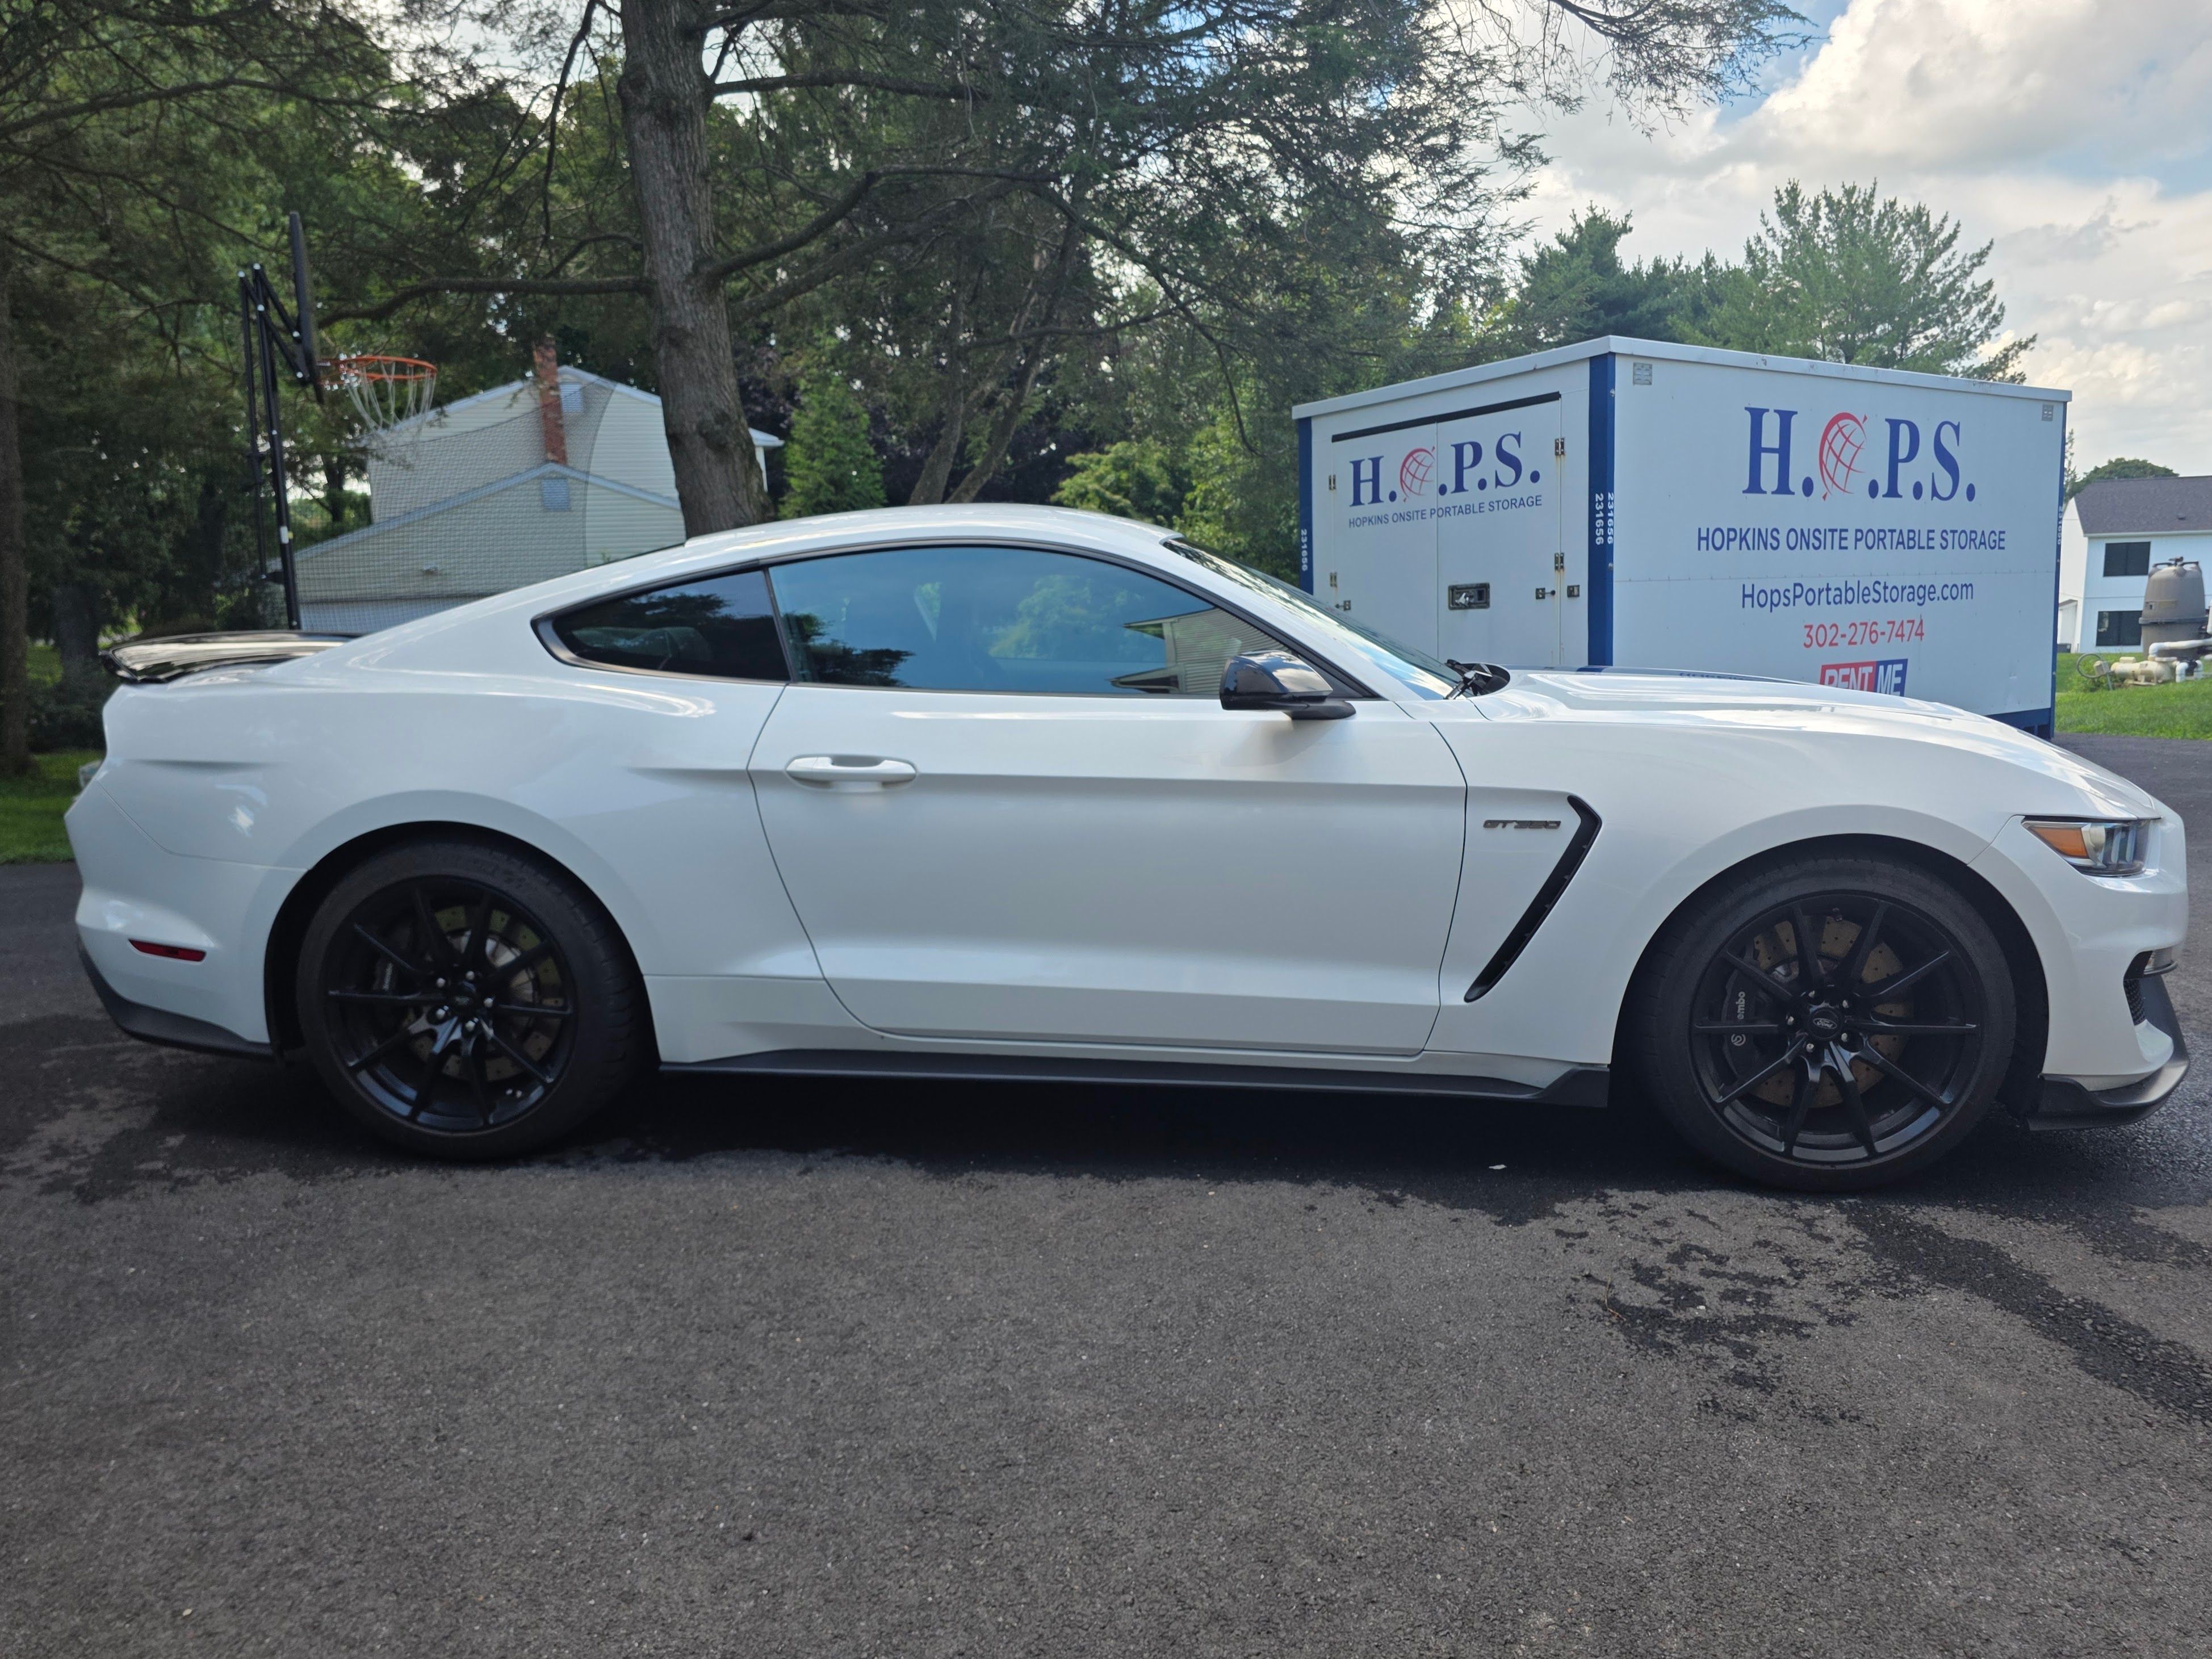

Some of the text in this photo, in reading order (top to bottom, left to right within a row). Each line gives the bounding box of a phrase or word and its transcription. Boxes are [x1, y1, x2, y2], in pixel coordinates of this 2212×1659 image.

[1349, 495, 1541, 528] HOPKINS ONSITE PORTABLE STORAGE
[1595, 493, 1604, 545] 231656
[1698, 527, 2005, 551] HOPKINS ONSITE PORTABLE STORAGE
[1742, 580, 1973, 613] HopsPortableStorage.com
[1803, 619, 1924, 648] 302-276-7474
[1876, 664, 1903, 696] ME
